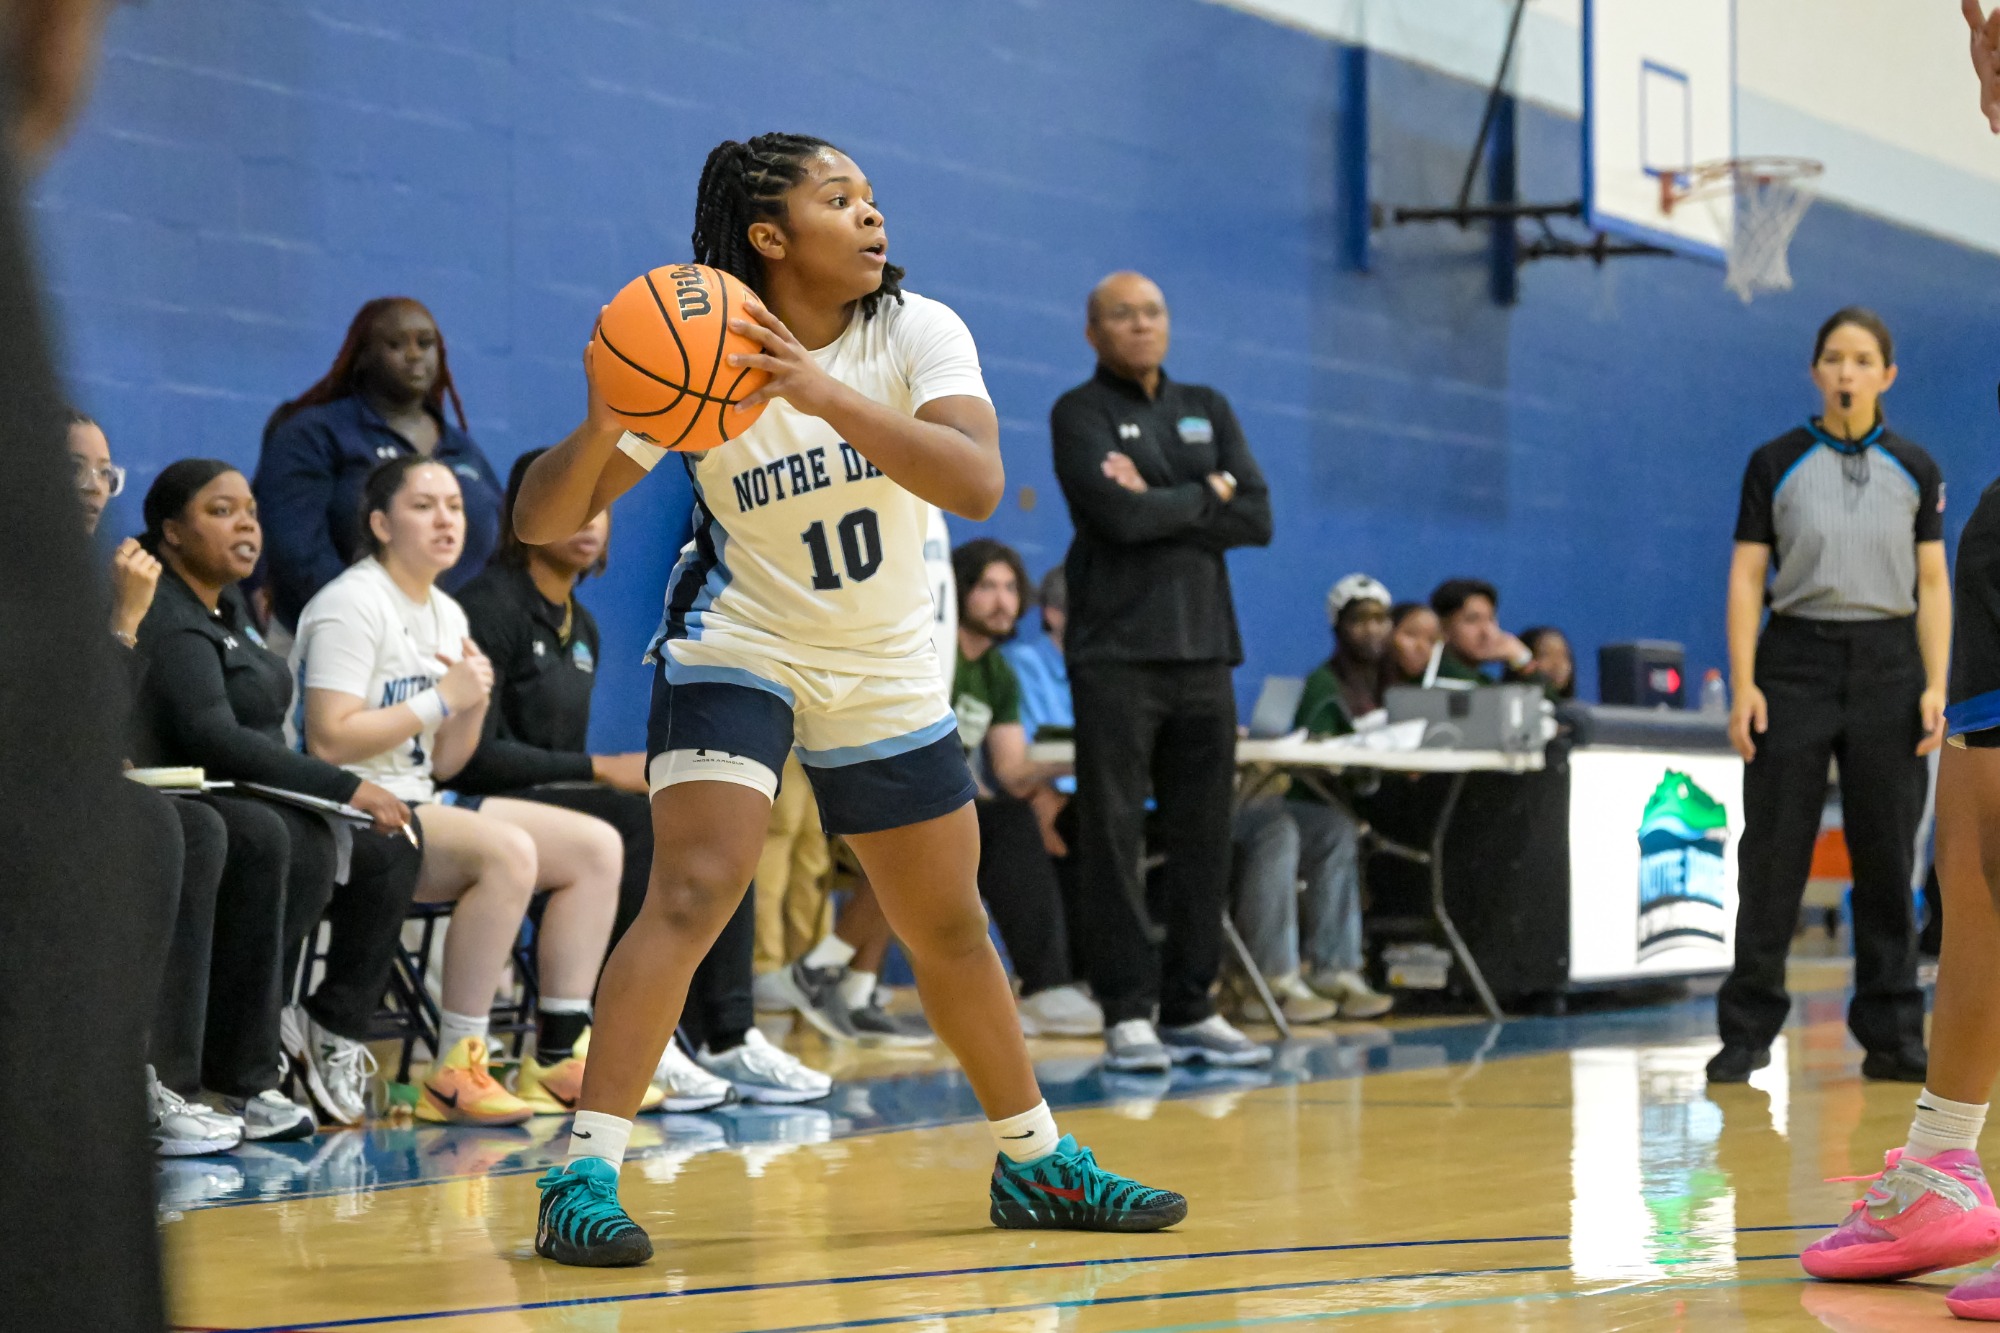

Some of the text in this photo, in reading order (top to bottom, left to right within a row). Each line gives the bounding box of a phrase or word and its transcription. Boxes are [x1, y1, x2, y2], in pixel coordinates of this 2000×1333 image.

[732, 443, 885, 513] NOTRE DA
[801, 507, 884, 591] 10
[379, 675, 436, 707] NOTR
